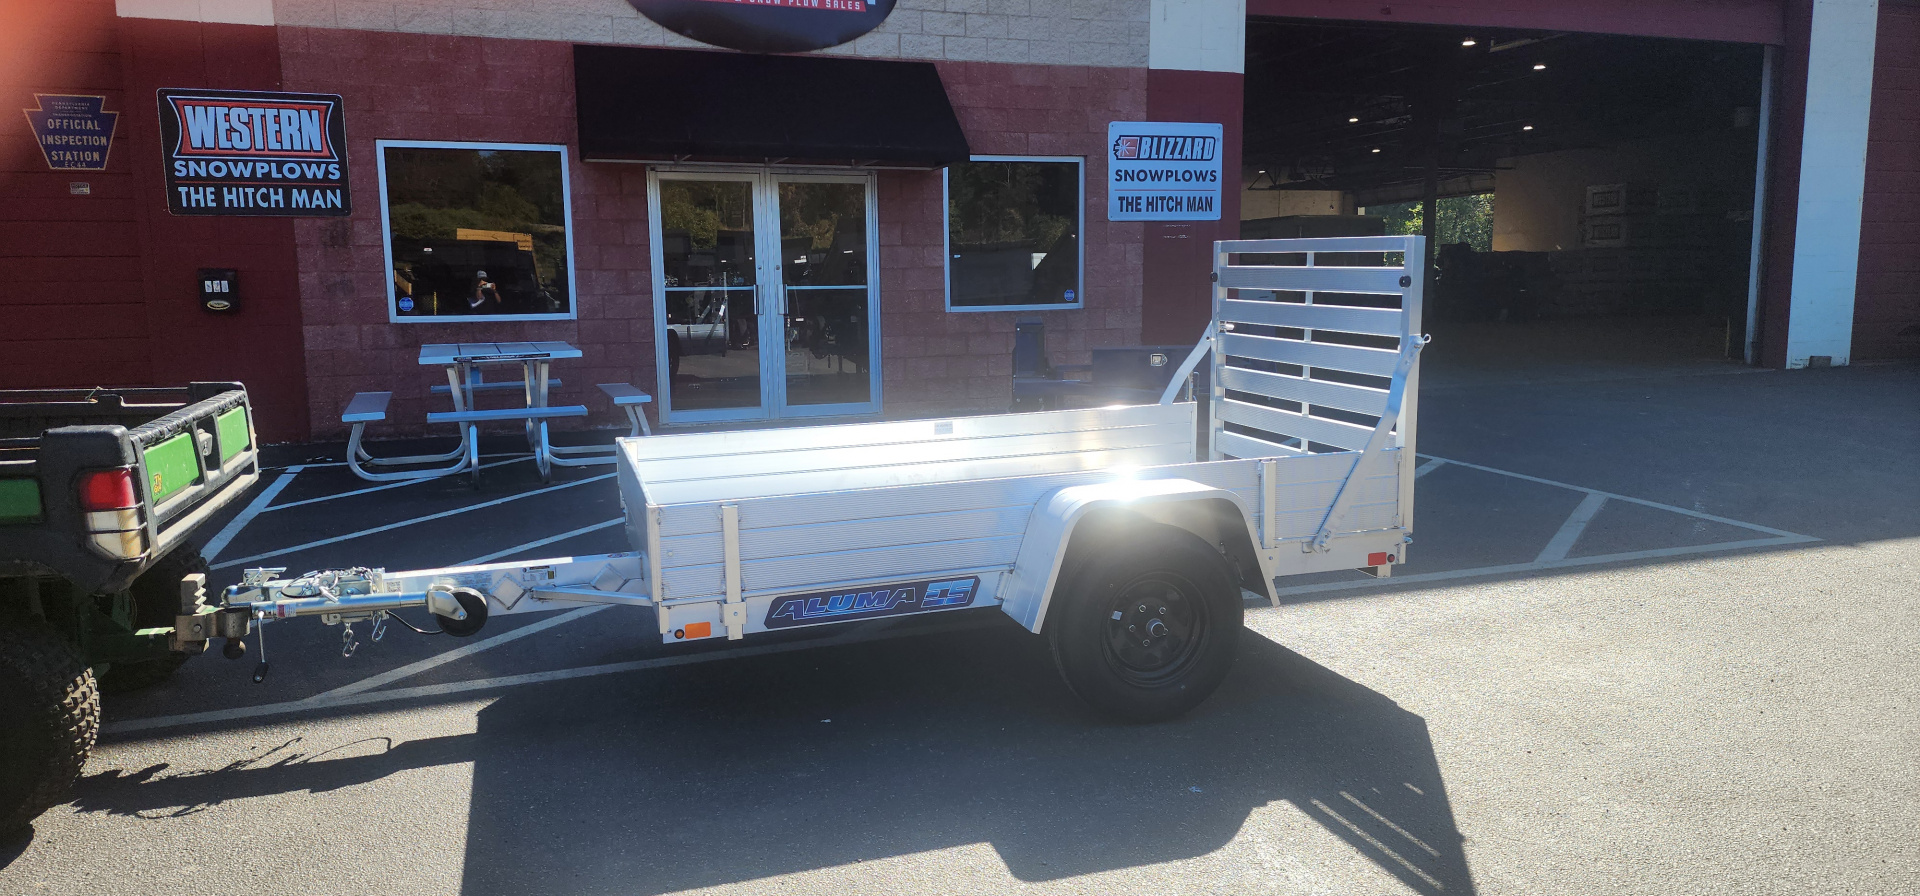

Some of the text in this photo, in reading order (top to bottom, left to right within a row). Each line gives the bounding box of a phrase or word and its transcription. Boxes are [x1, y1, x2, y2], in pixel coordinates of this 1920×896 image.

[826, 1, 860, 10] SALES
[47, 118, 101, 130] OFFICIAL
[183, 105, 322, 151] WESTERN
[42, 134, 107, 146] INSPECTION
[1140, 136, 1216, 160] BLIZZARD
[51, 150, 100, 162] STATION
[174, 160, 341, 180] SNOWPLOWS
[1115, 169, 1217, 182] SNOWPLOWS
[178, 186, 342, 209] THE HITCH MAN
[1118, 196, 1213, 212] THE HITCH MAN
[772, 587, 916, 619] ALUMA
